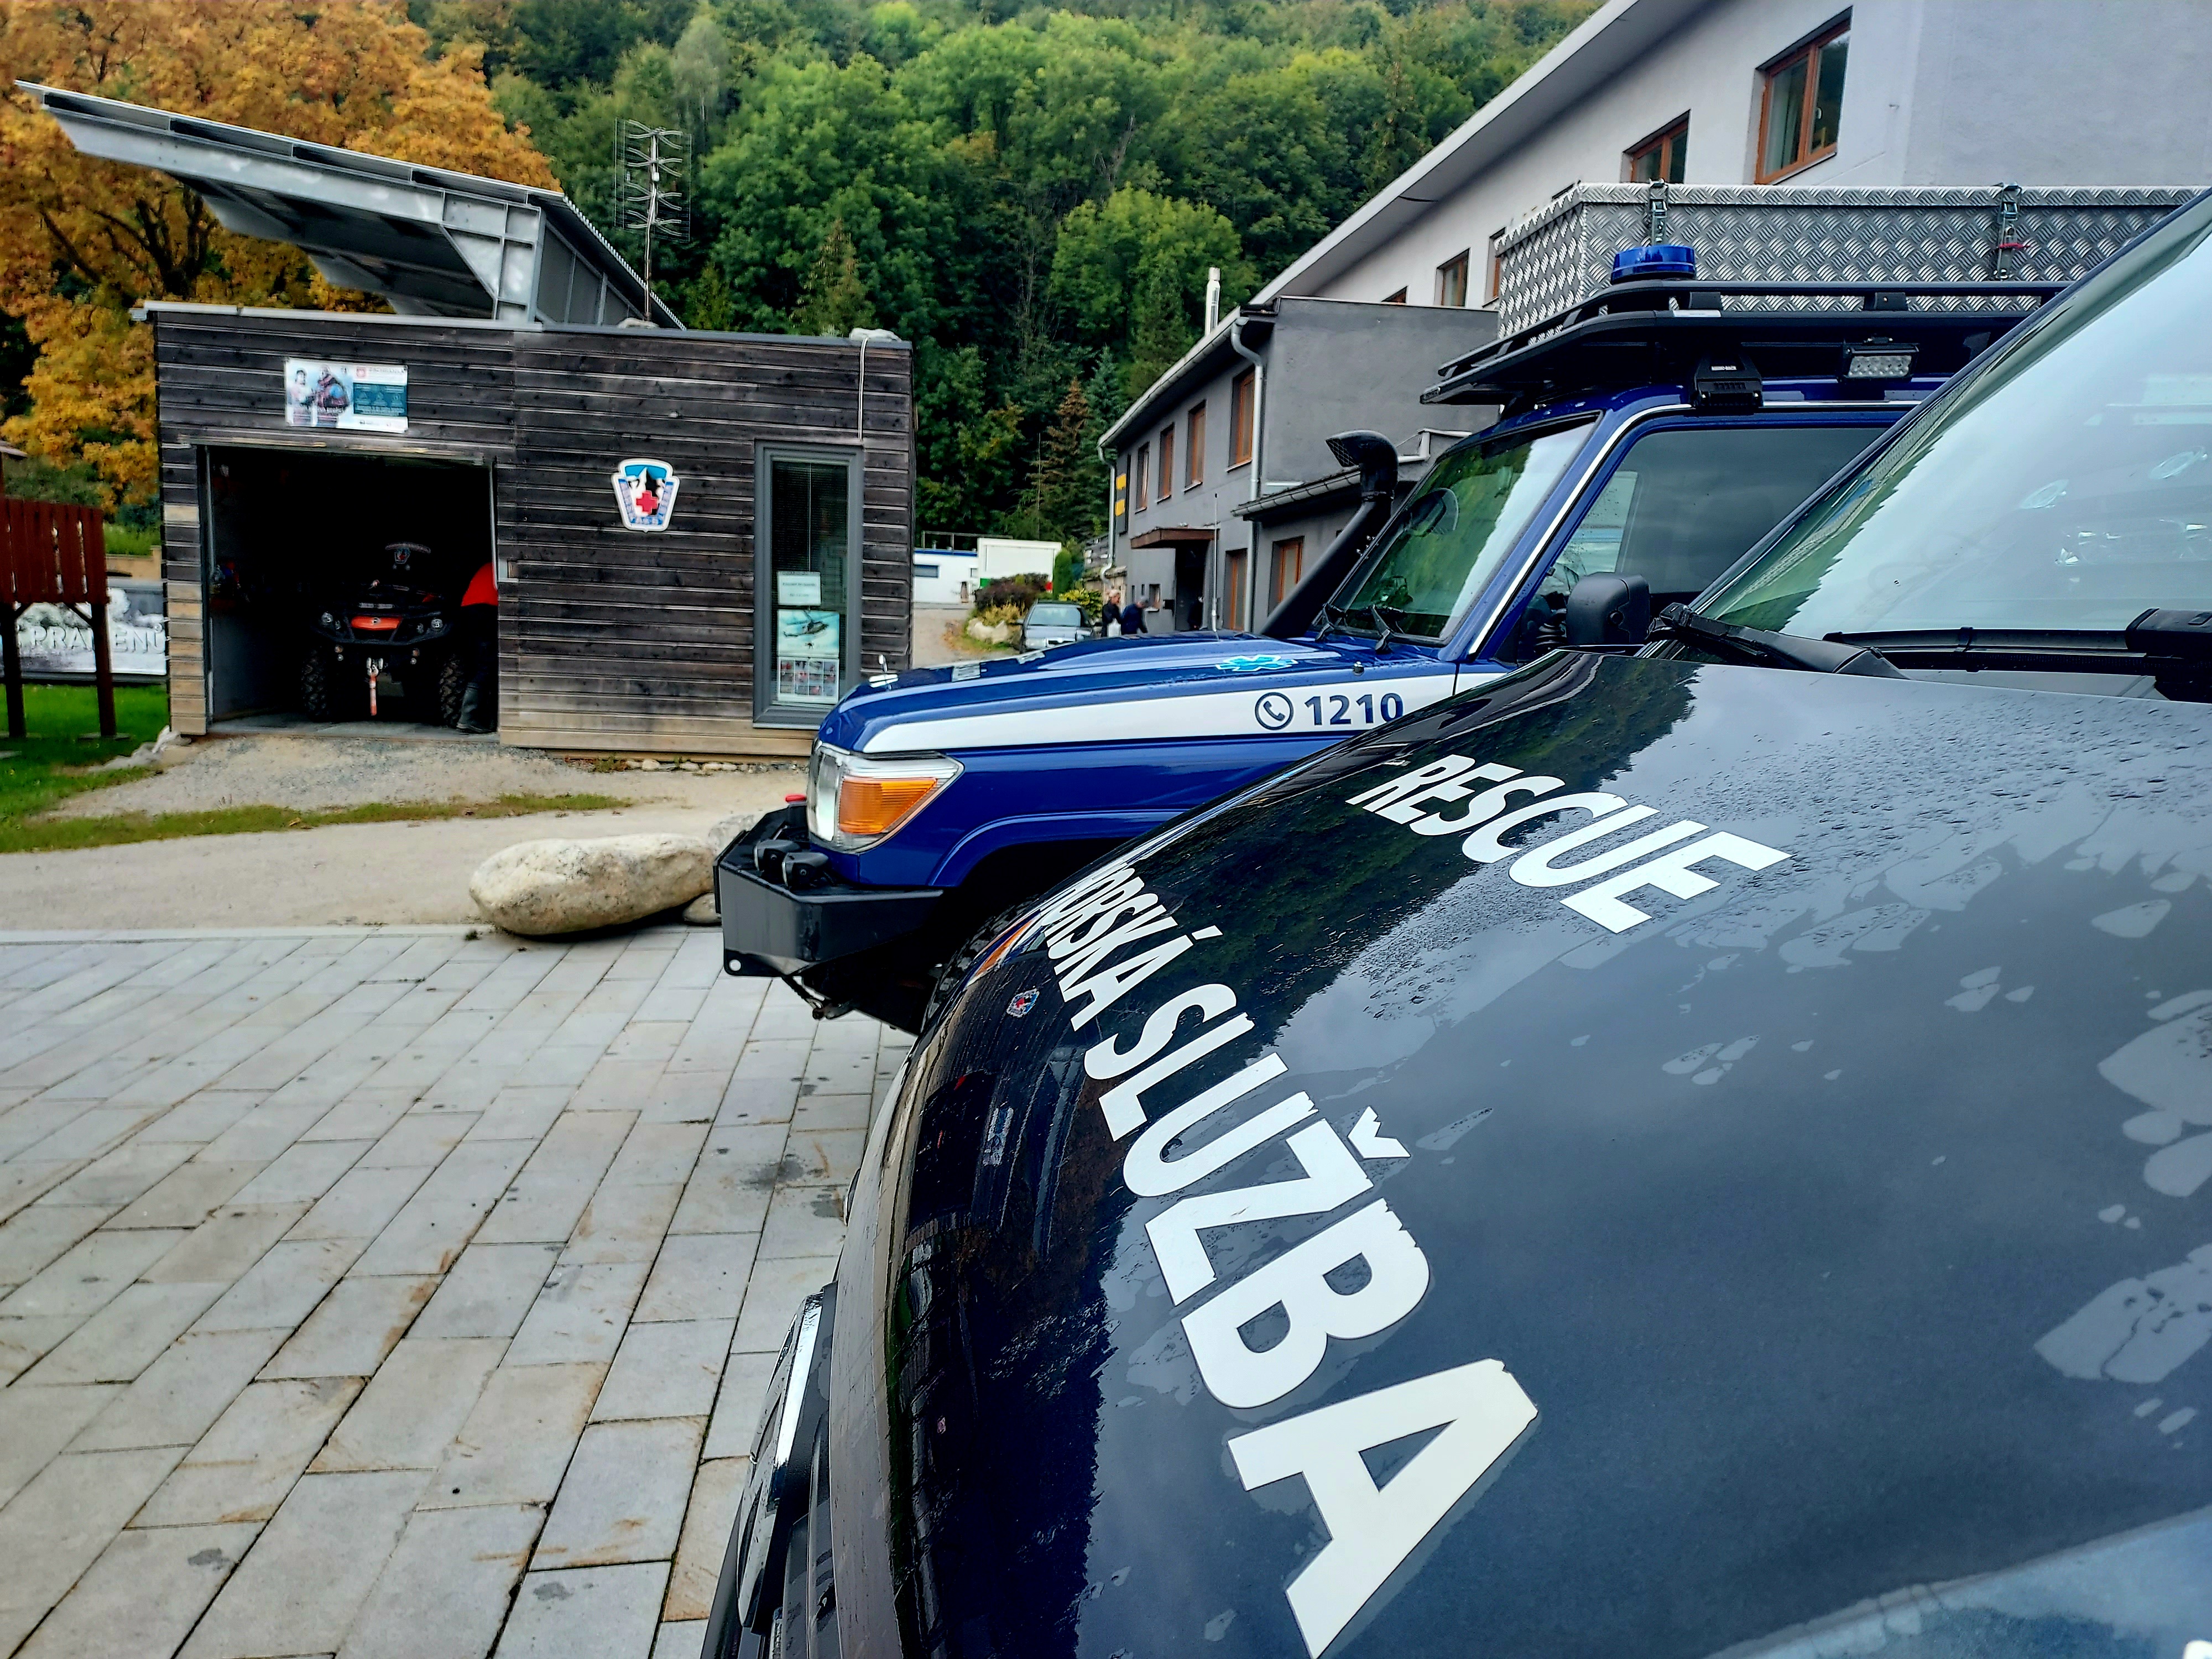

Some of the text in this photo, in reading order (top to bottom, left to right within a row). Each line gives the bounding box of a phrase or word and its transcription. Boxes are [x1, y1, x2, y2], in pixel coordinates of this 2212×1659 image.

[29, 623, 165, 654] PRAENŮ
[1304, 692, 1405, 726] 1210
[1345, 754, 1792, 934] RESCUE
[1084, 983, 1538, 1659] SLUŽBA
